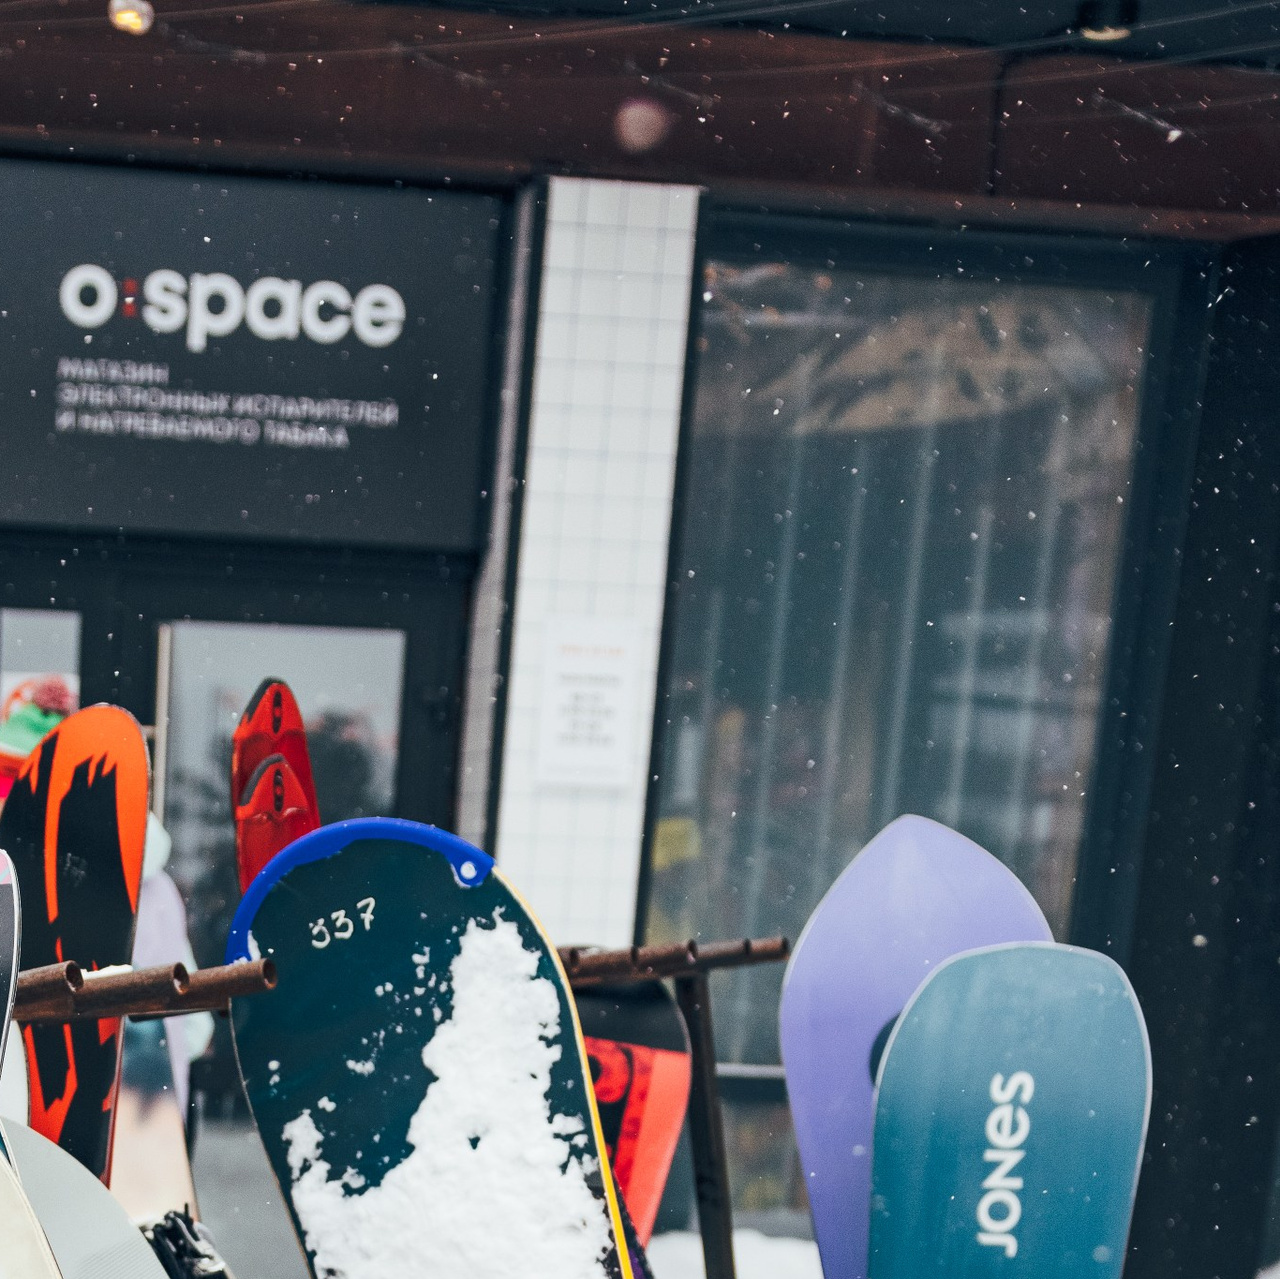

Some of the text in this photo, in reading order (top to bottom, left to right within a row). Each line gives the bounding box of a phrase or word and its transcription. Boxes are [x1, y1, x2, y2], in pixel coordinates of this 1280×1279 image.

[56, 357, 169, 384] МАГАЗИН
[55, 382, 399, 427] ЭЛЕКТРОННЫХ ИСПАРИТЕЛЕЙ
[77, 410, 261, 446] НАГРЕВАЕМОГО
[263, 419, 350, 449] ТАБАКА
